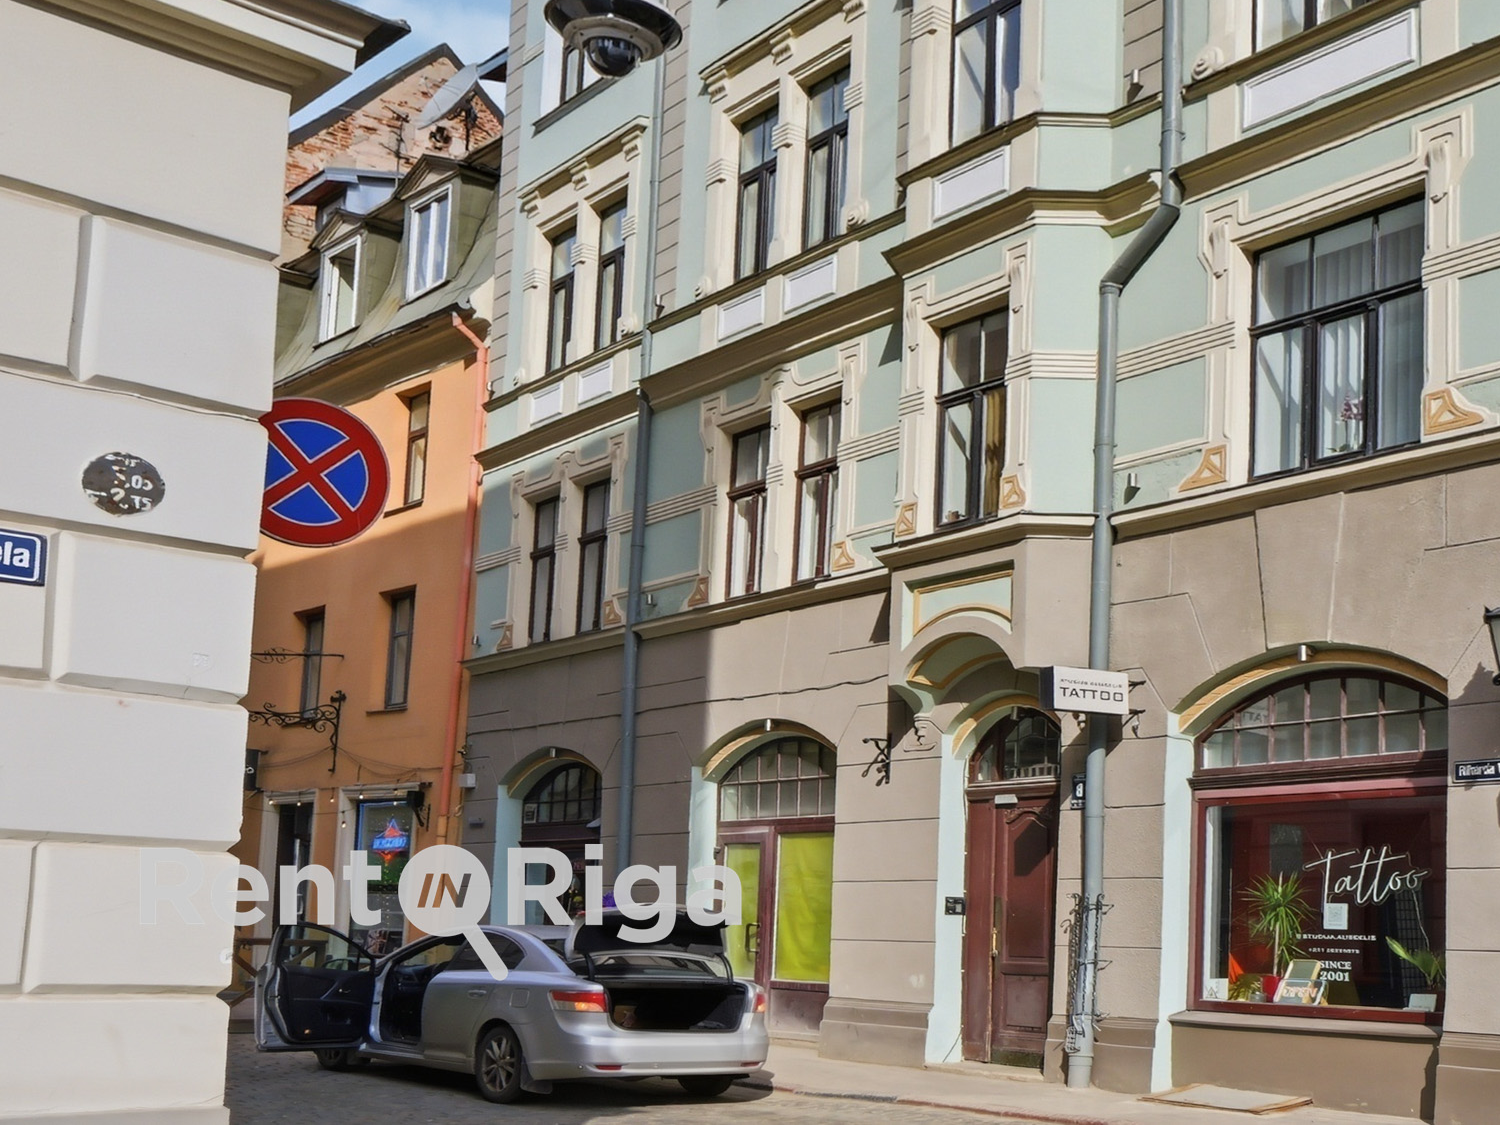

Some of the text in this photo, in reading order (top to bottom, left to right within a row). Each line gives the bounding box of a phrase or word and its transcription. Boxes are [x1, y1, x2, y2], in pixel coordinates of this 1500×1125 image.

[0, 541, 30, 568] la
[1060, 687, 1123, 702] TATTOO
[1304, 846, 1428, 904] Tattoo
[1319, 960, 1352, 970] SINCE
[1319, 971, 1350, 982] 2001
